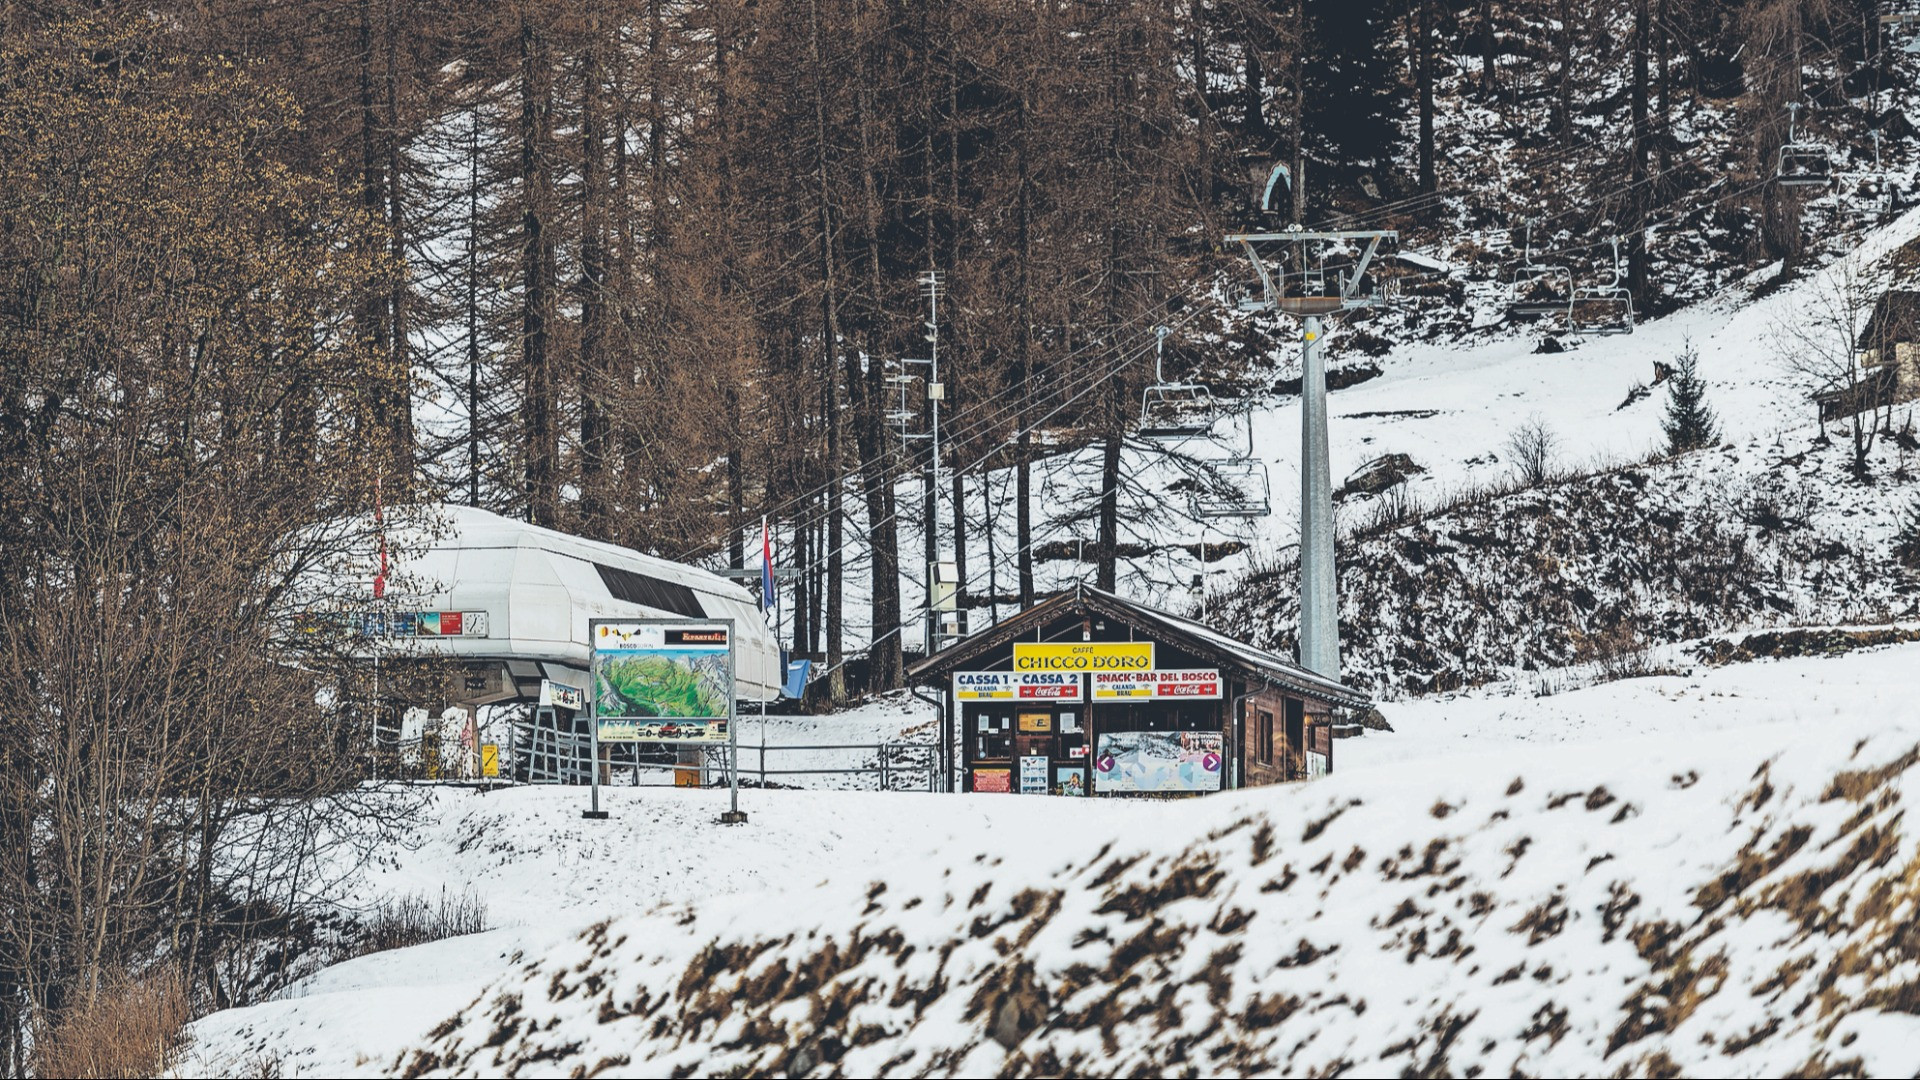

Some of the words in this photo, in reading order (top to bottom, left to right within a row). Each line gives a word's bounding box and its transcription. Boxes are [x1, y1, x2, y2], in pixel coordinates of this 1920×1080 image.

[1018, 656, 1088, 669] CHICCO
[1093, 655, 1148, 669] D'ORO
[958, 675, 1000, 684] CASSA
[1003, 674, 1009, 684] 1
[1022, 674, 1064, 684] CASSA
[1069, 674, 1078, 684] 2
[1096, 673, 1157, 682] SNACK-BAR
[1160, 673, 1179, 682] DEL
[1182, 672, 1217, 681] BOSCO
